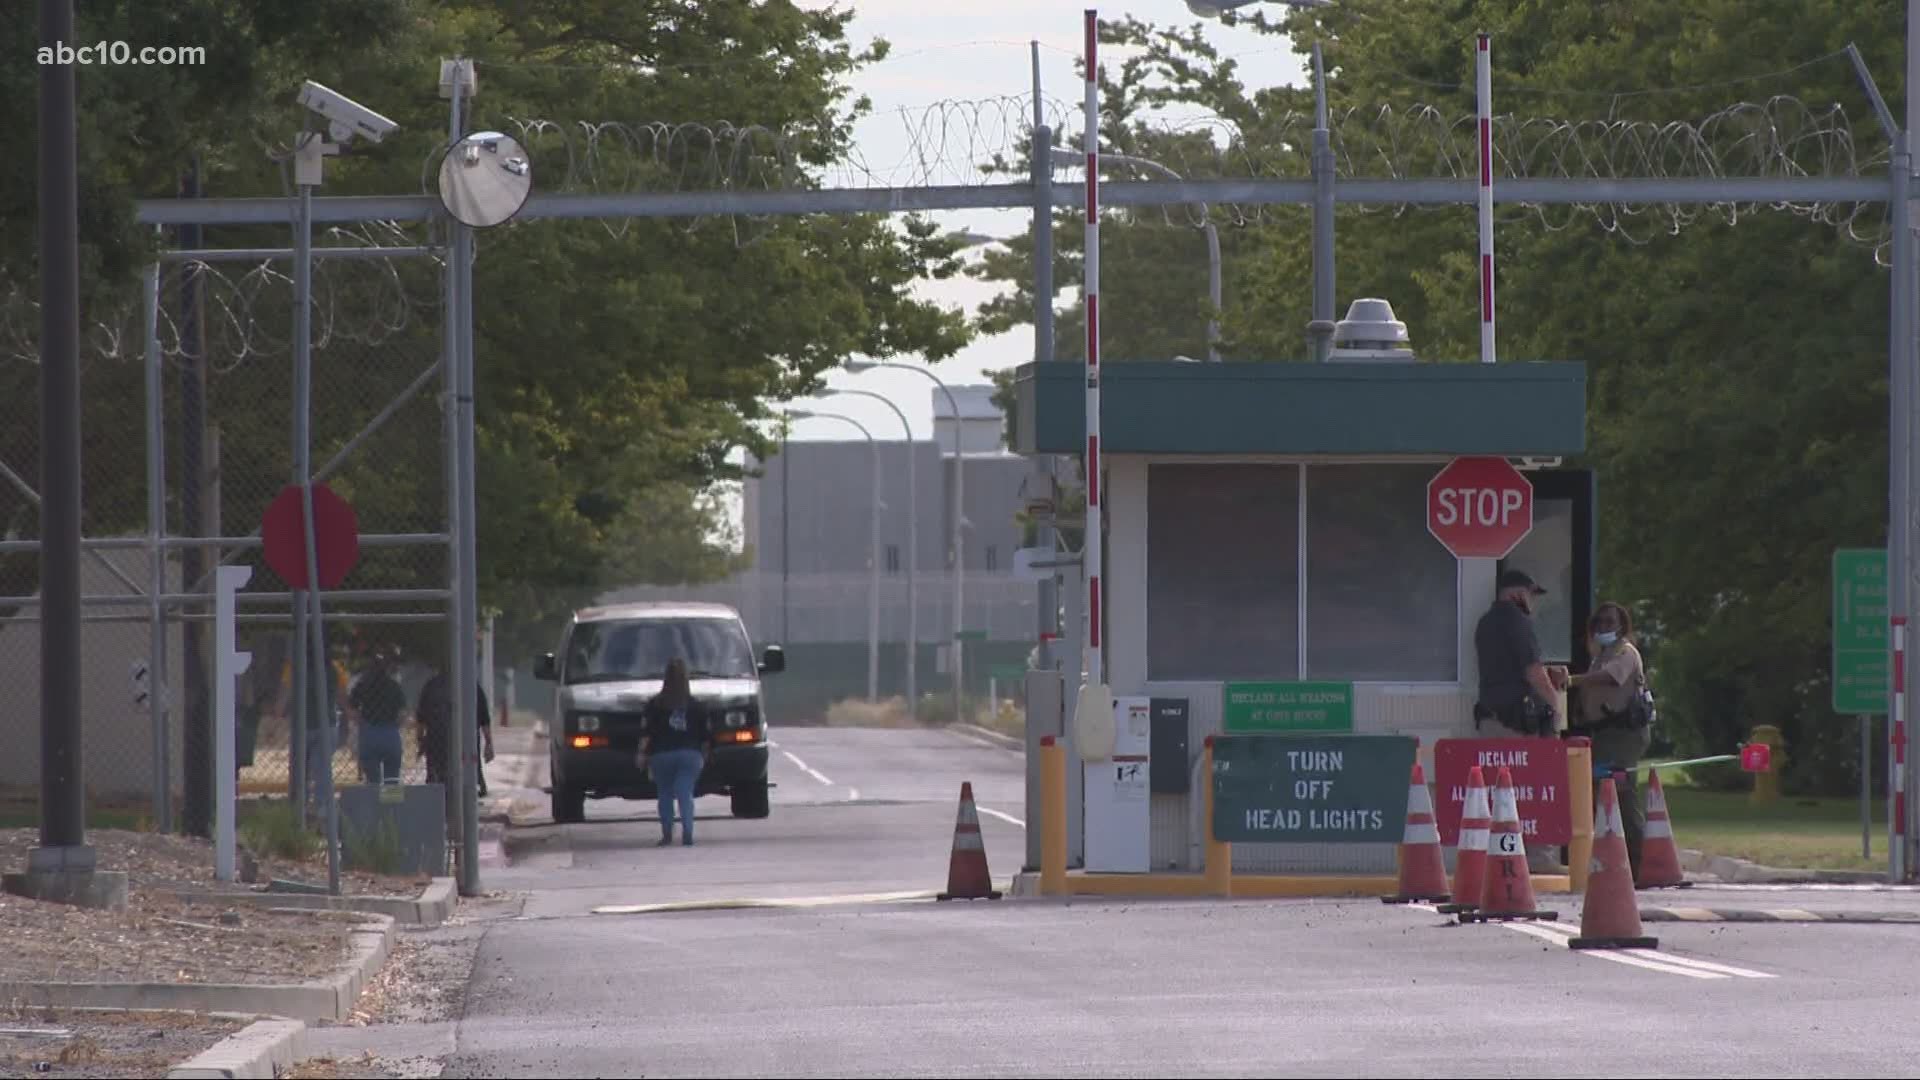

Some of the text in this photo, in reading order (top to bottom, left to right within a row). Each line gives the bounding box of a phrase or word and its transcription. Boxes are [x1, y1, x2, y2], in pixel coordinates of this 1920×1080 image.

[1437, 487, 1523, 526] STOP
[1287, 751, 1343, 771] TURN
[1478, 751, 1529, 766] DECLARE
[1294, 780, 1334, 800] OFF
[1451, 785, 1466, 801] AL
[1541, 785, 1556, 801] AT
[1246, 809, 1383, 830] HEAD LIGHTS
